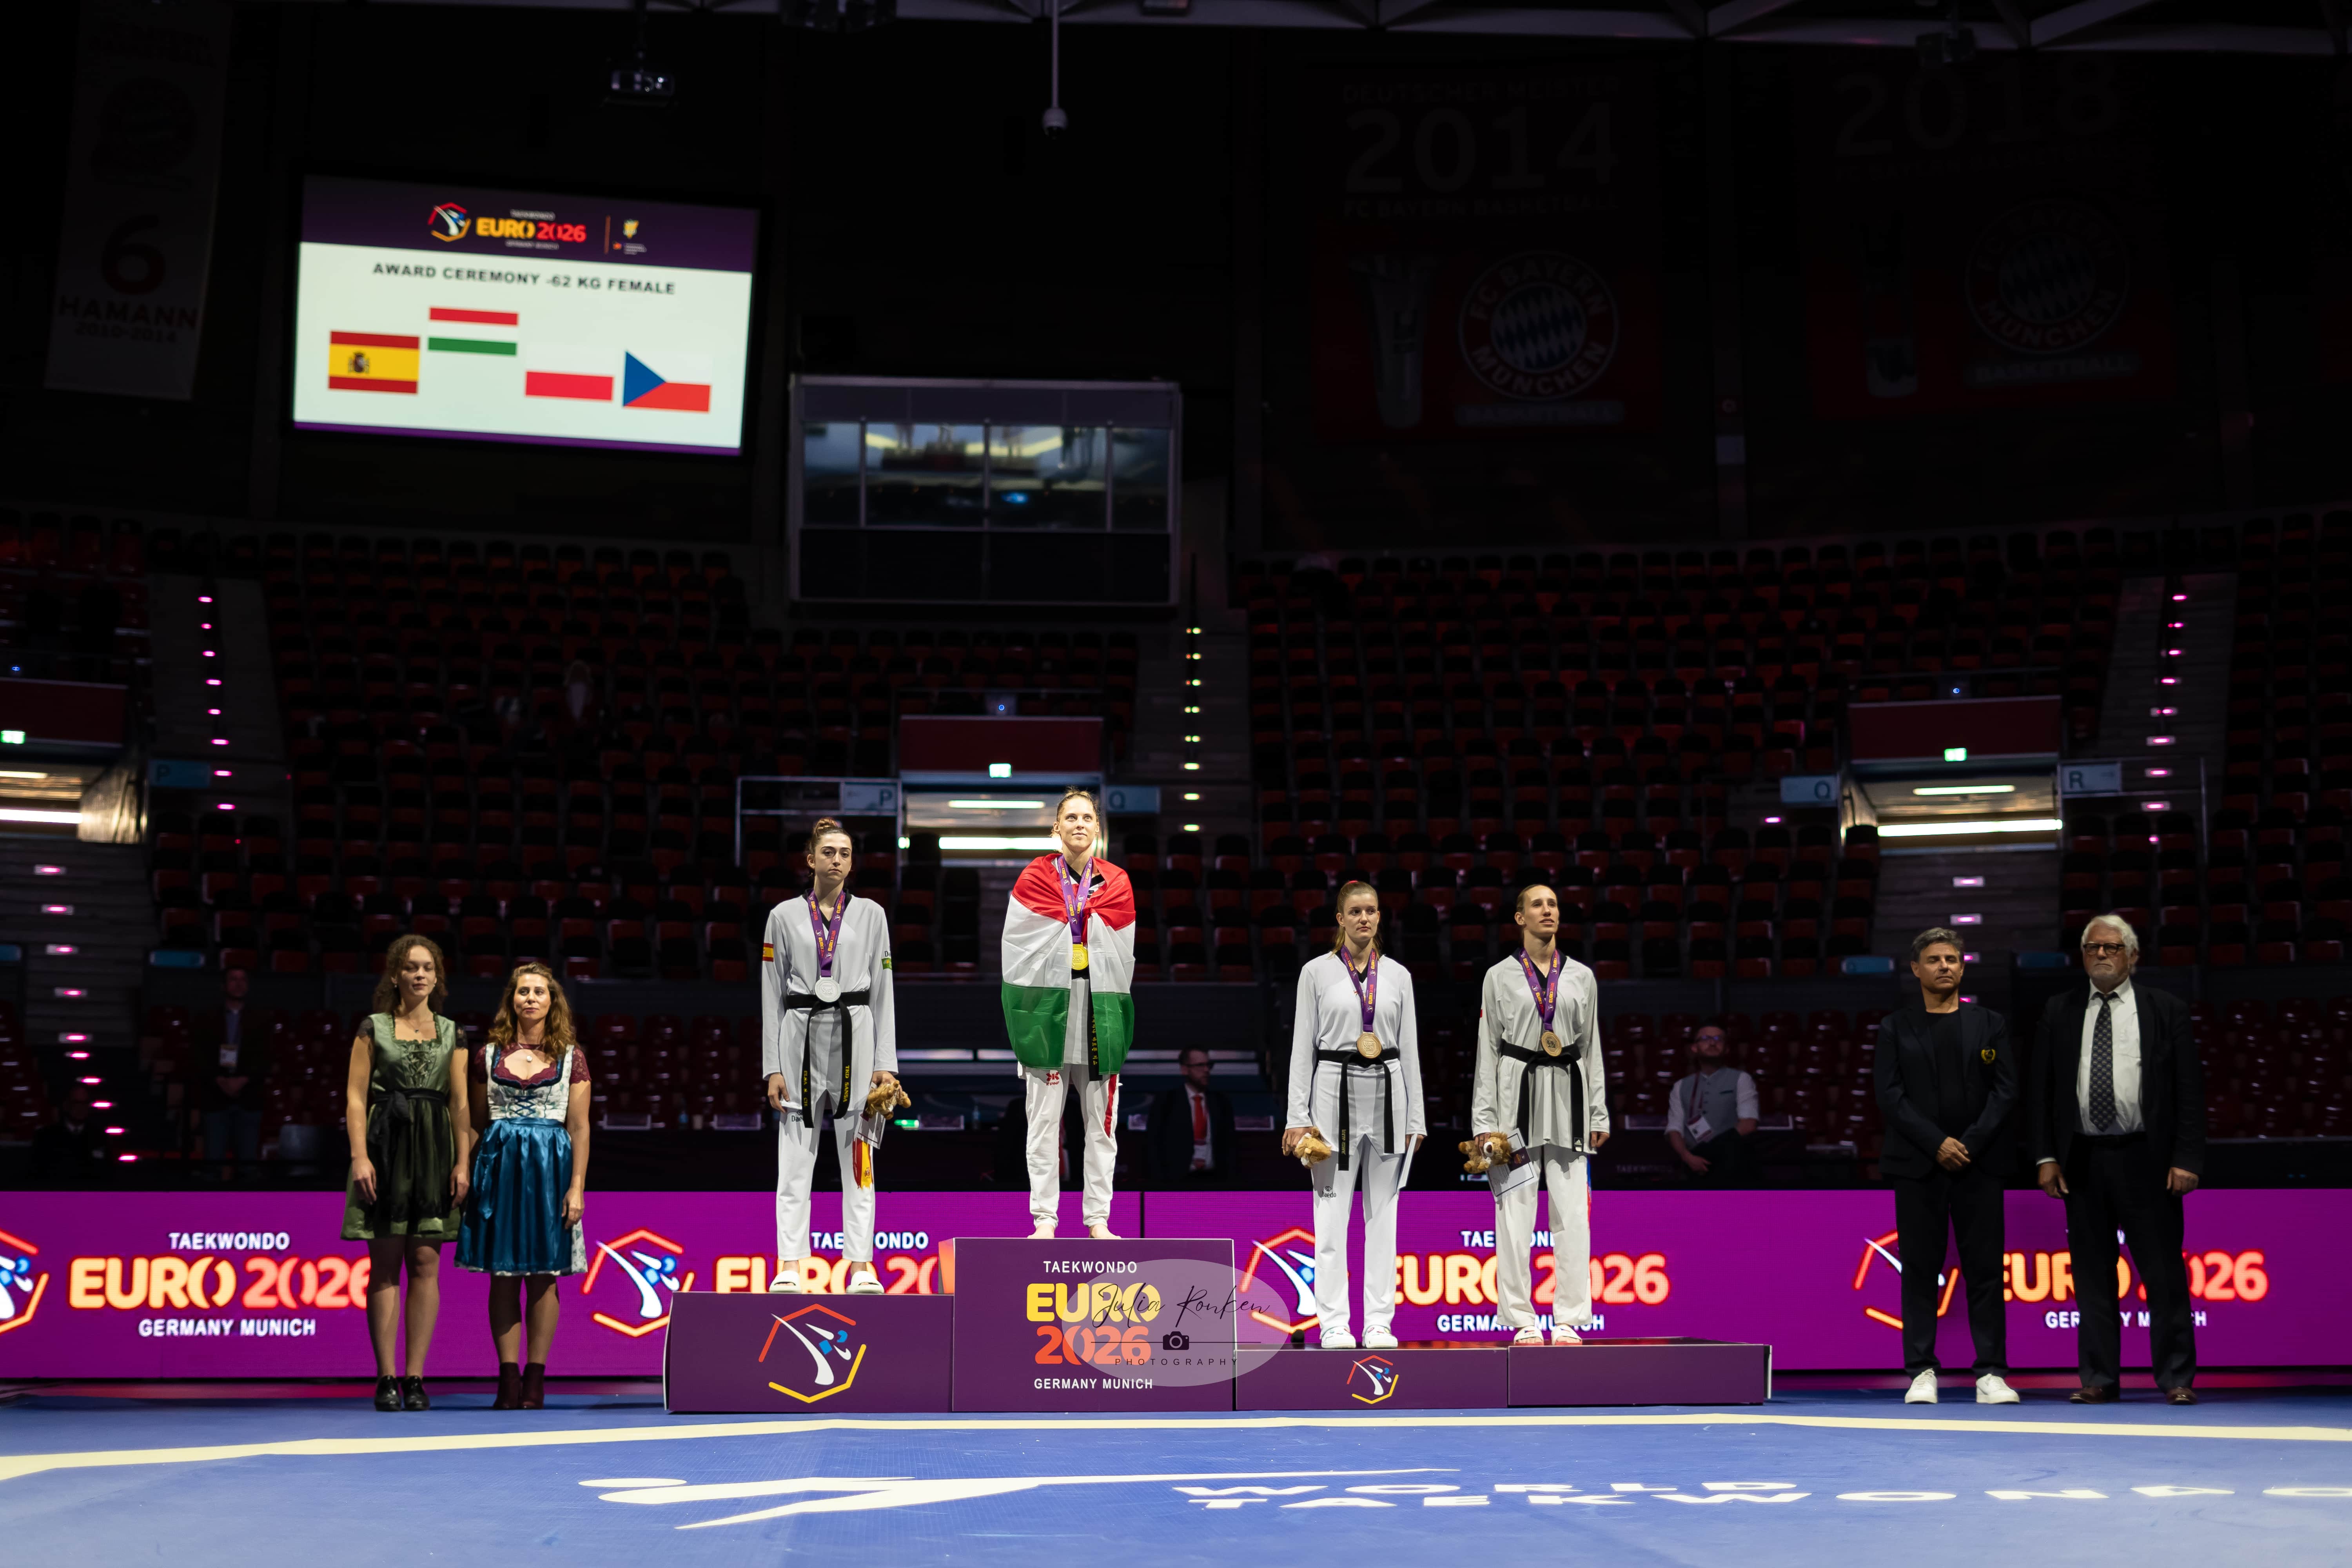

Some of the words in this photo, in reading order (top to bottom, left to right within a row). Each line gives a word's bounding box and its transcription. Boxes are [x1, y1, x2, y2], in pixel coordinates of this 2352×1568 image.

[1832, 51, 2118, 156] 2018
[1345, 102, 1619, 194] 2014
[475, 217, 536, 239] EURO
[537, 222, 587, 243] 2026
[101, 214, 165, 295] 6
[373, 263, 436, 278] AWARD
[443, 268, 540, 285] CEREMONY
[546, 275, 571, 288] -62
[578, 277, 602, 289] KG
[608, 279, 675, 295] FEMALE
[59, 296, 198, 327] HAMANN
[75, 321, 177, 343] 2010-2014
[2069, 771, 2083, 788] R
[879, 789, 892, 806] P
[1109, 791, 1126, 809] Q
[1814, 780, 1831, 800] Q
[169, 1232, 290, 1250] TAEKWONDO
[810, 1232, 929, 1250] TAEONDO
[1043, 1261, 1137, 1274] TAEKWONDO
[70, 1256, 237, 1309] EURO
[1026, 1283, 1161, 1323] EURO
[138, 1318, 234, 1337] GERMANY
[240, 1318, 316, 1337] MUNICH
[2045, 1310, 2132, 1329] GERY
[1034, 1325, 1152, 1365] 2026
[1034, 1378, 1097, 1389] GERMANY
[1103, 1378, 1153, 1389] MUNICH
[1172, 1483, 1797, 1495] WORLD
